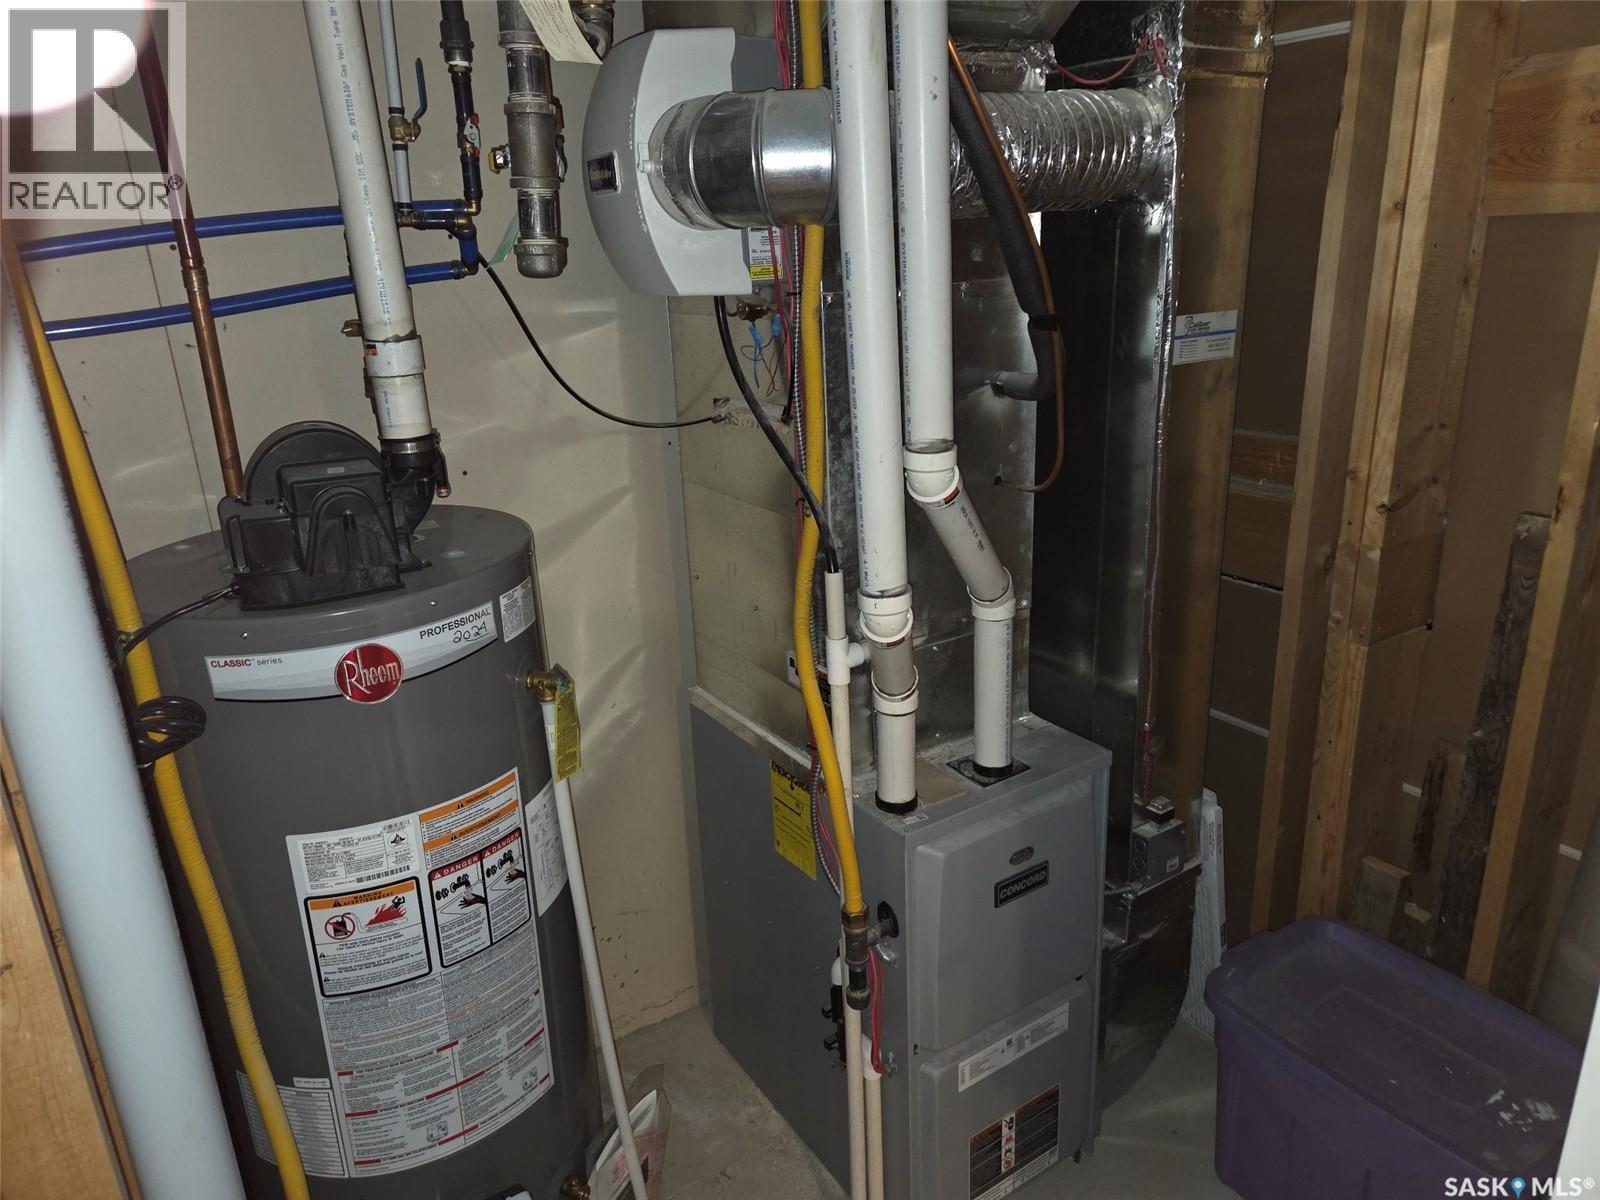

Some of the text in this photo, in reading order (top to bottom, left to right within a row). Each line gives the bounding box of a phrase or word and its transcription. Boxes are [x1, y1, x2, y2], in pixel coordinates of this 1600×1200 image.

[419, 607, 492, 639] PROFESSIONAL
[256, 656, 283, 667] series
[343, 646, 400, 695] Rheem
[490, 831, 521, 855] DANGER
[442, 855, 480, 876] DANGER
[999, 870, 1046, 899] CONCORD
